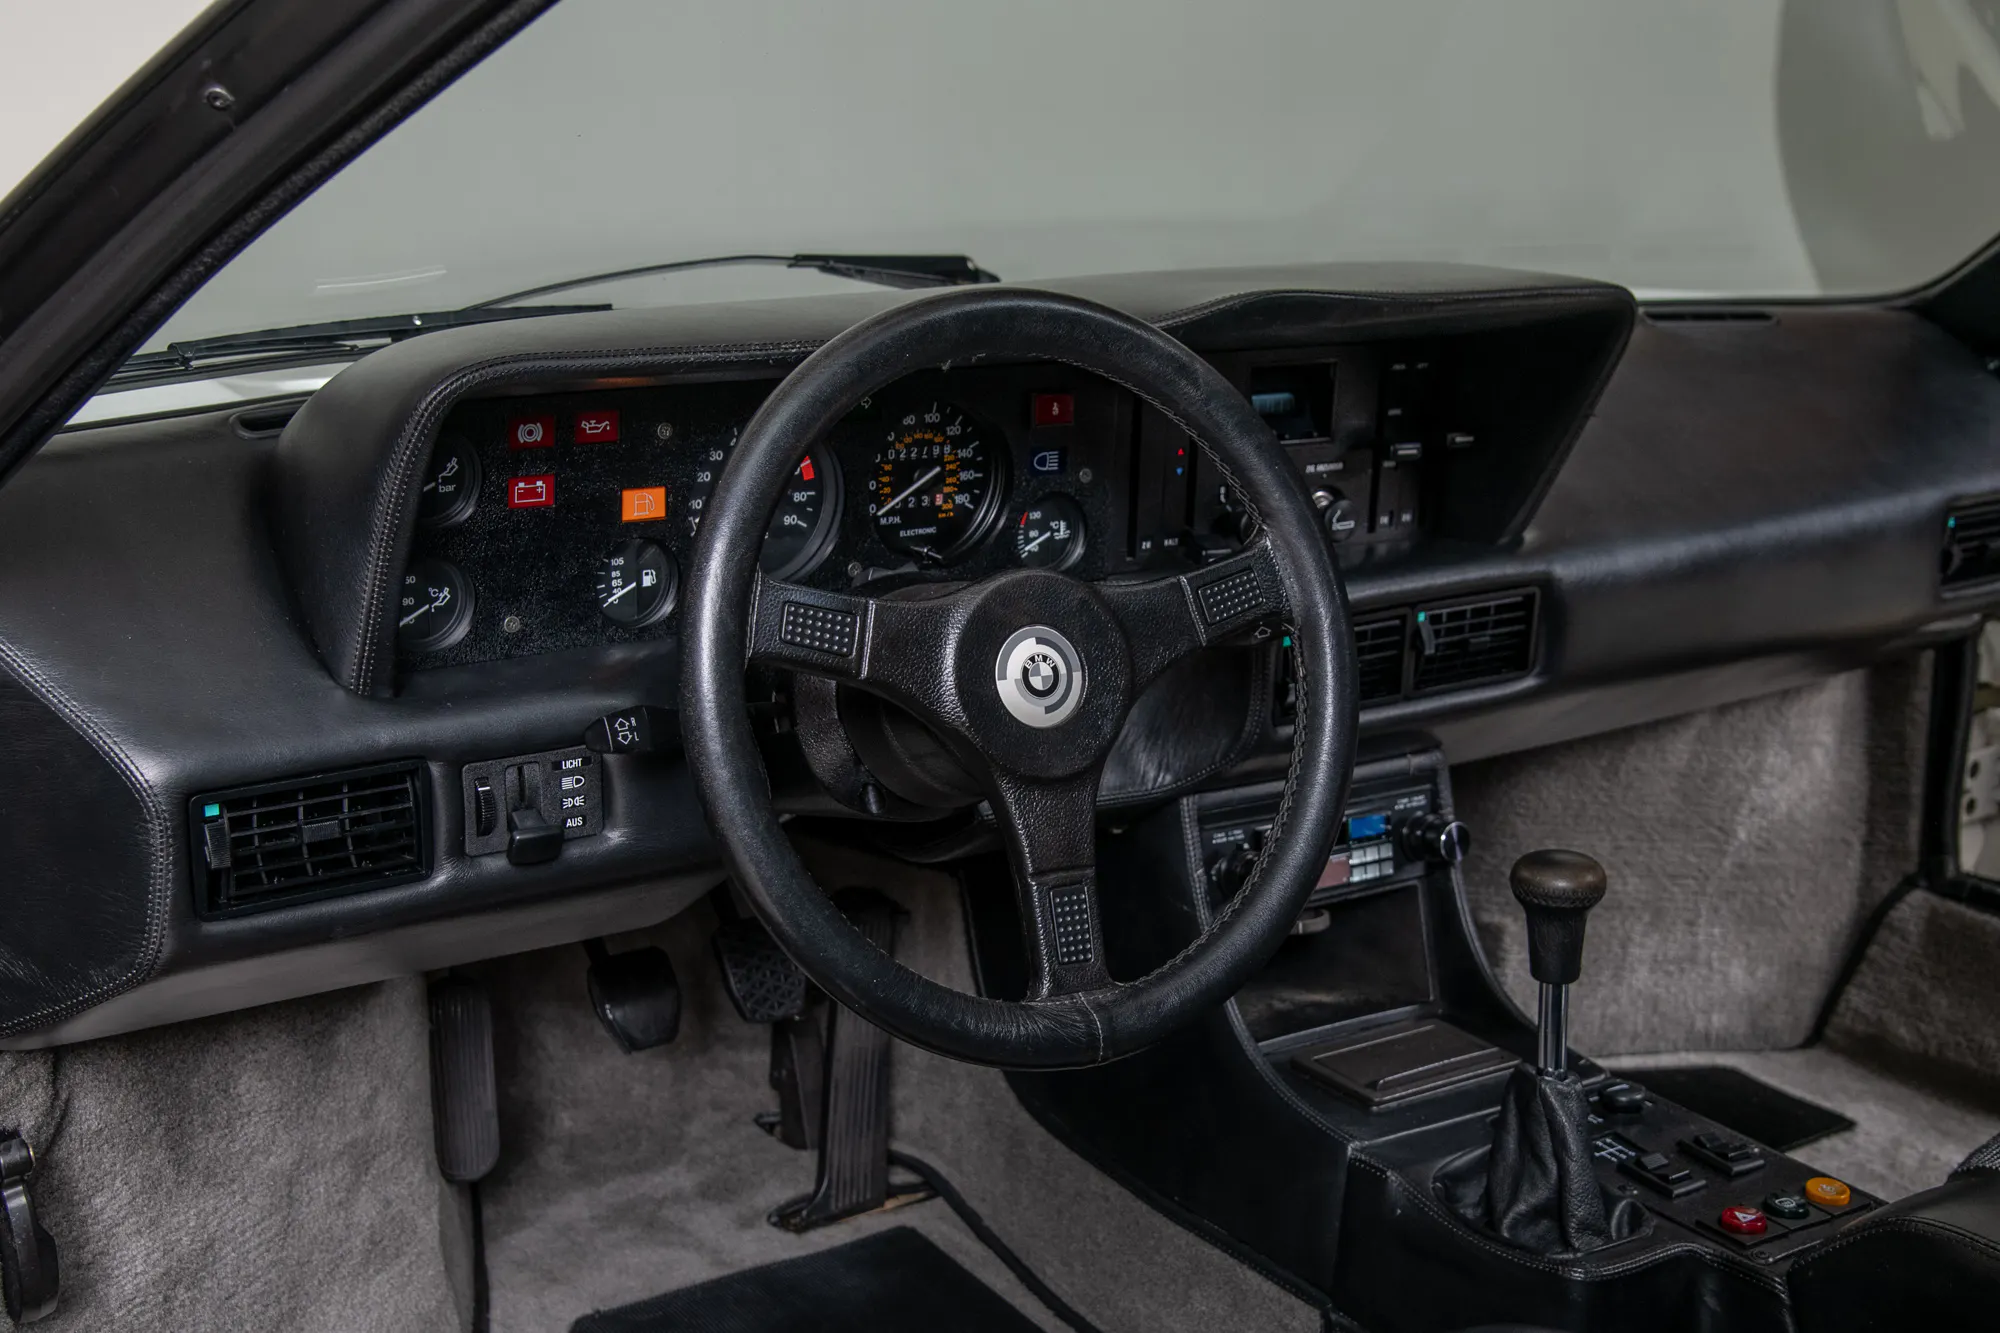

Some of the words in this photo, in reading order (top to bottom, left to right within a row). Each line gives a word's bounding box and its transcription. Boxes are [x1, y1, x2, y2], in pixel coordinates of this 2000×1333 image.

[923, 412, 940, 423] 100
[945, 425, 961, 436] 120
[709, 451, 723, 461] 30
[957, 448, 973, 458] 140
[697, 471, 711, 482] 20
[959, 470, 975, 481] 160
[438, 482, 456, 493] bar
[793, 491, 807, 502] 80
[954, 493, 970, 504] 180
[691, 499, 703, 510] 10
[869, 504, 877, 513] 0
[783, 515, 798, 525] 90
[900, 527, 936, 537] ELECTRONIC
[611, 557, 624, 566] 105
[611, 570, 621, 578] 85
[612, 578, 623, 587] 65
[1024, 654, 1056, 669] BMW
[630, 717, 637, 727] R
[633, 732, 640, 742] L
[562, 757, 583, 769] LICHT
[566, 817, 583, 828] AUS
